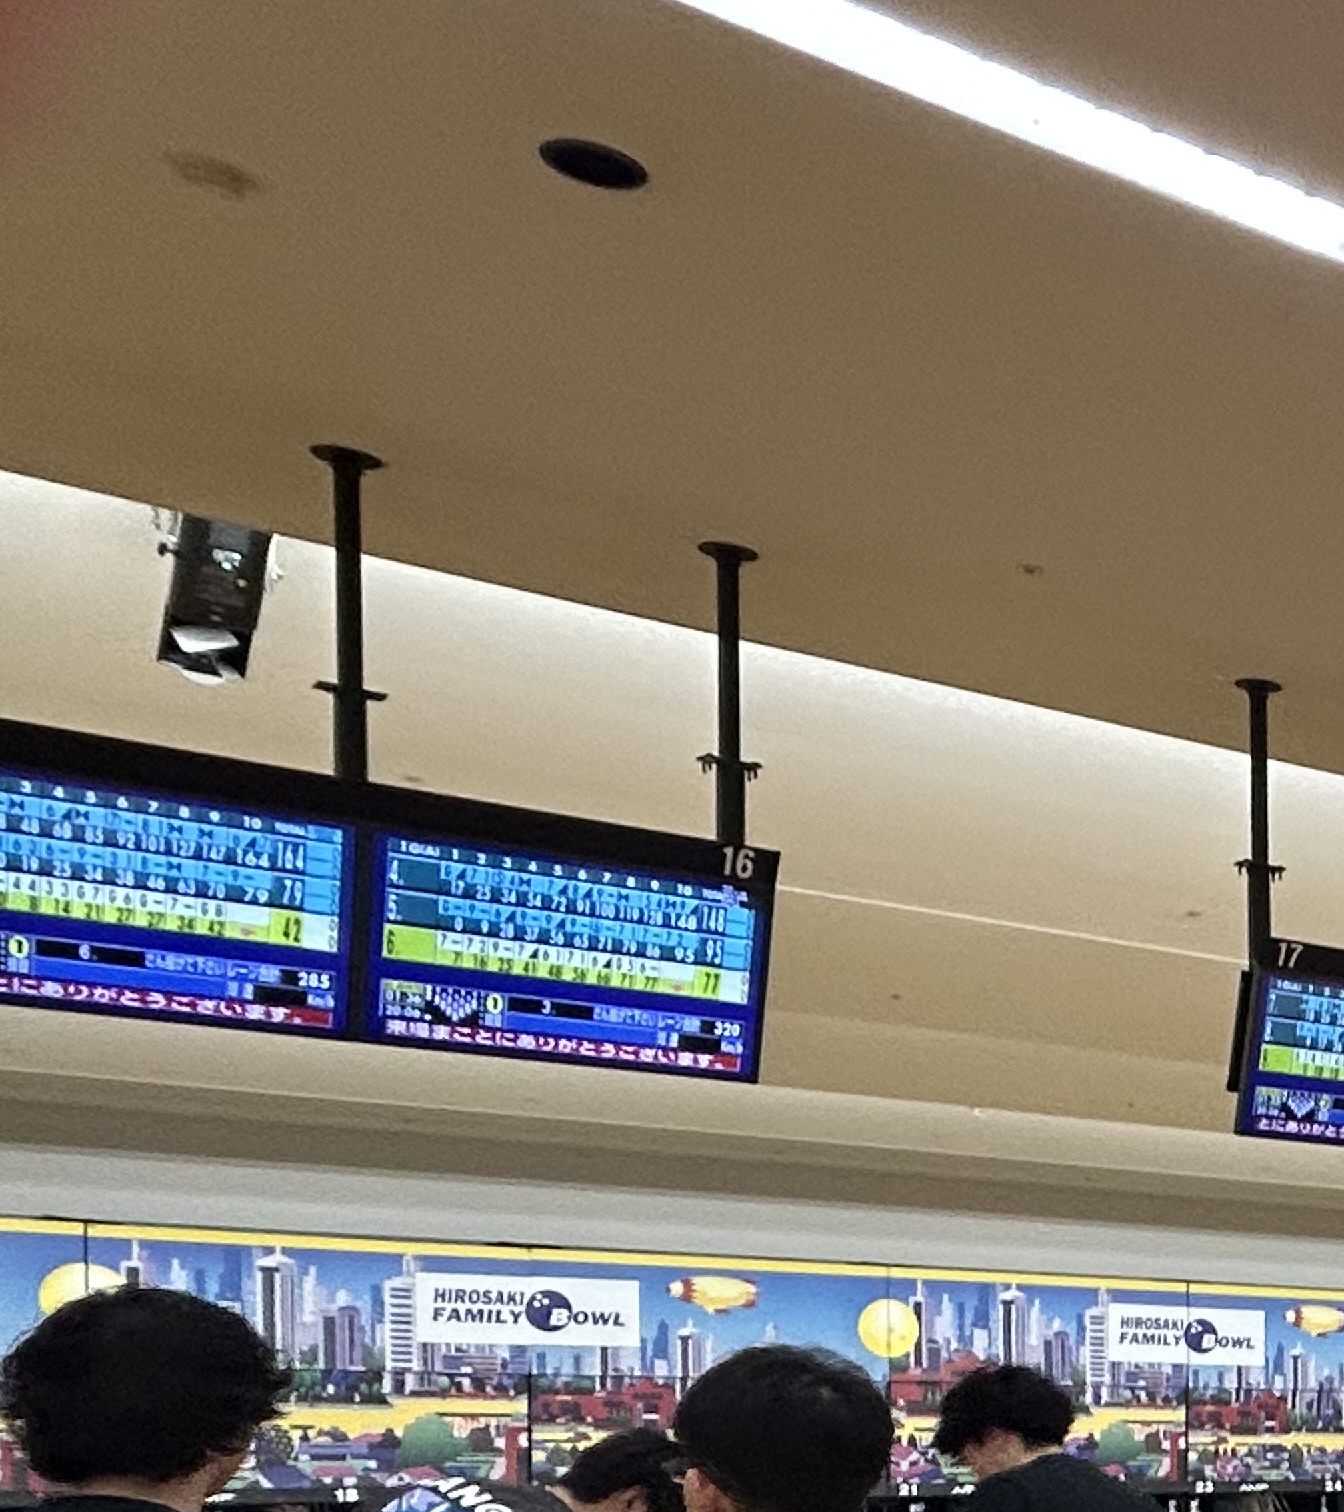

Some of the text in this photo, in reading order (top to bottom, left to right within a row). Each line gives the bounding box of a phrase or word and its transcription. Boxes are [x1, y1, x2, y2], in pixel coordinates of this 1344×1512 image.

[723, 846, 755, 879] 16
[1278, 942, 1303, 969] 17
[298, 972, 330, 990] 285
[714, 1021, 740, 1037] 320
[434, 1287, 525, 1306] HIROSAKI
[432, 1307, 625, 1327] FAMILY BOWL
[1120, 1315, 1183, 1331] HIROSAKI
[1119, 1332, 1183, 1346] FAMILY
